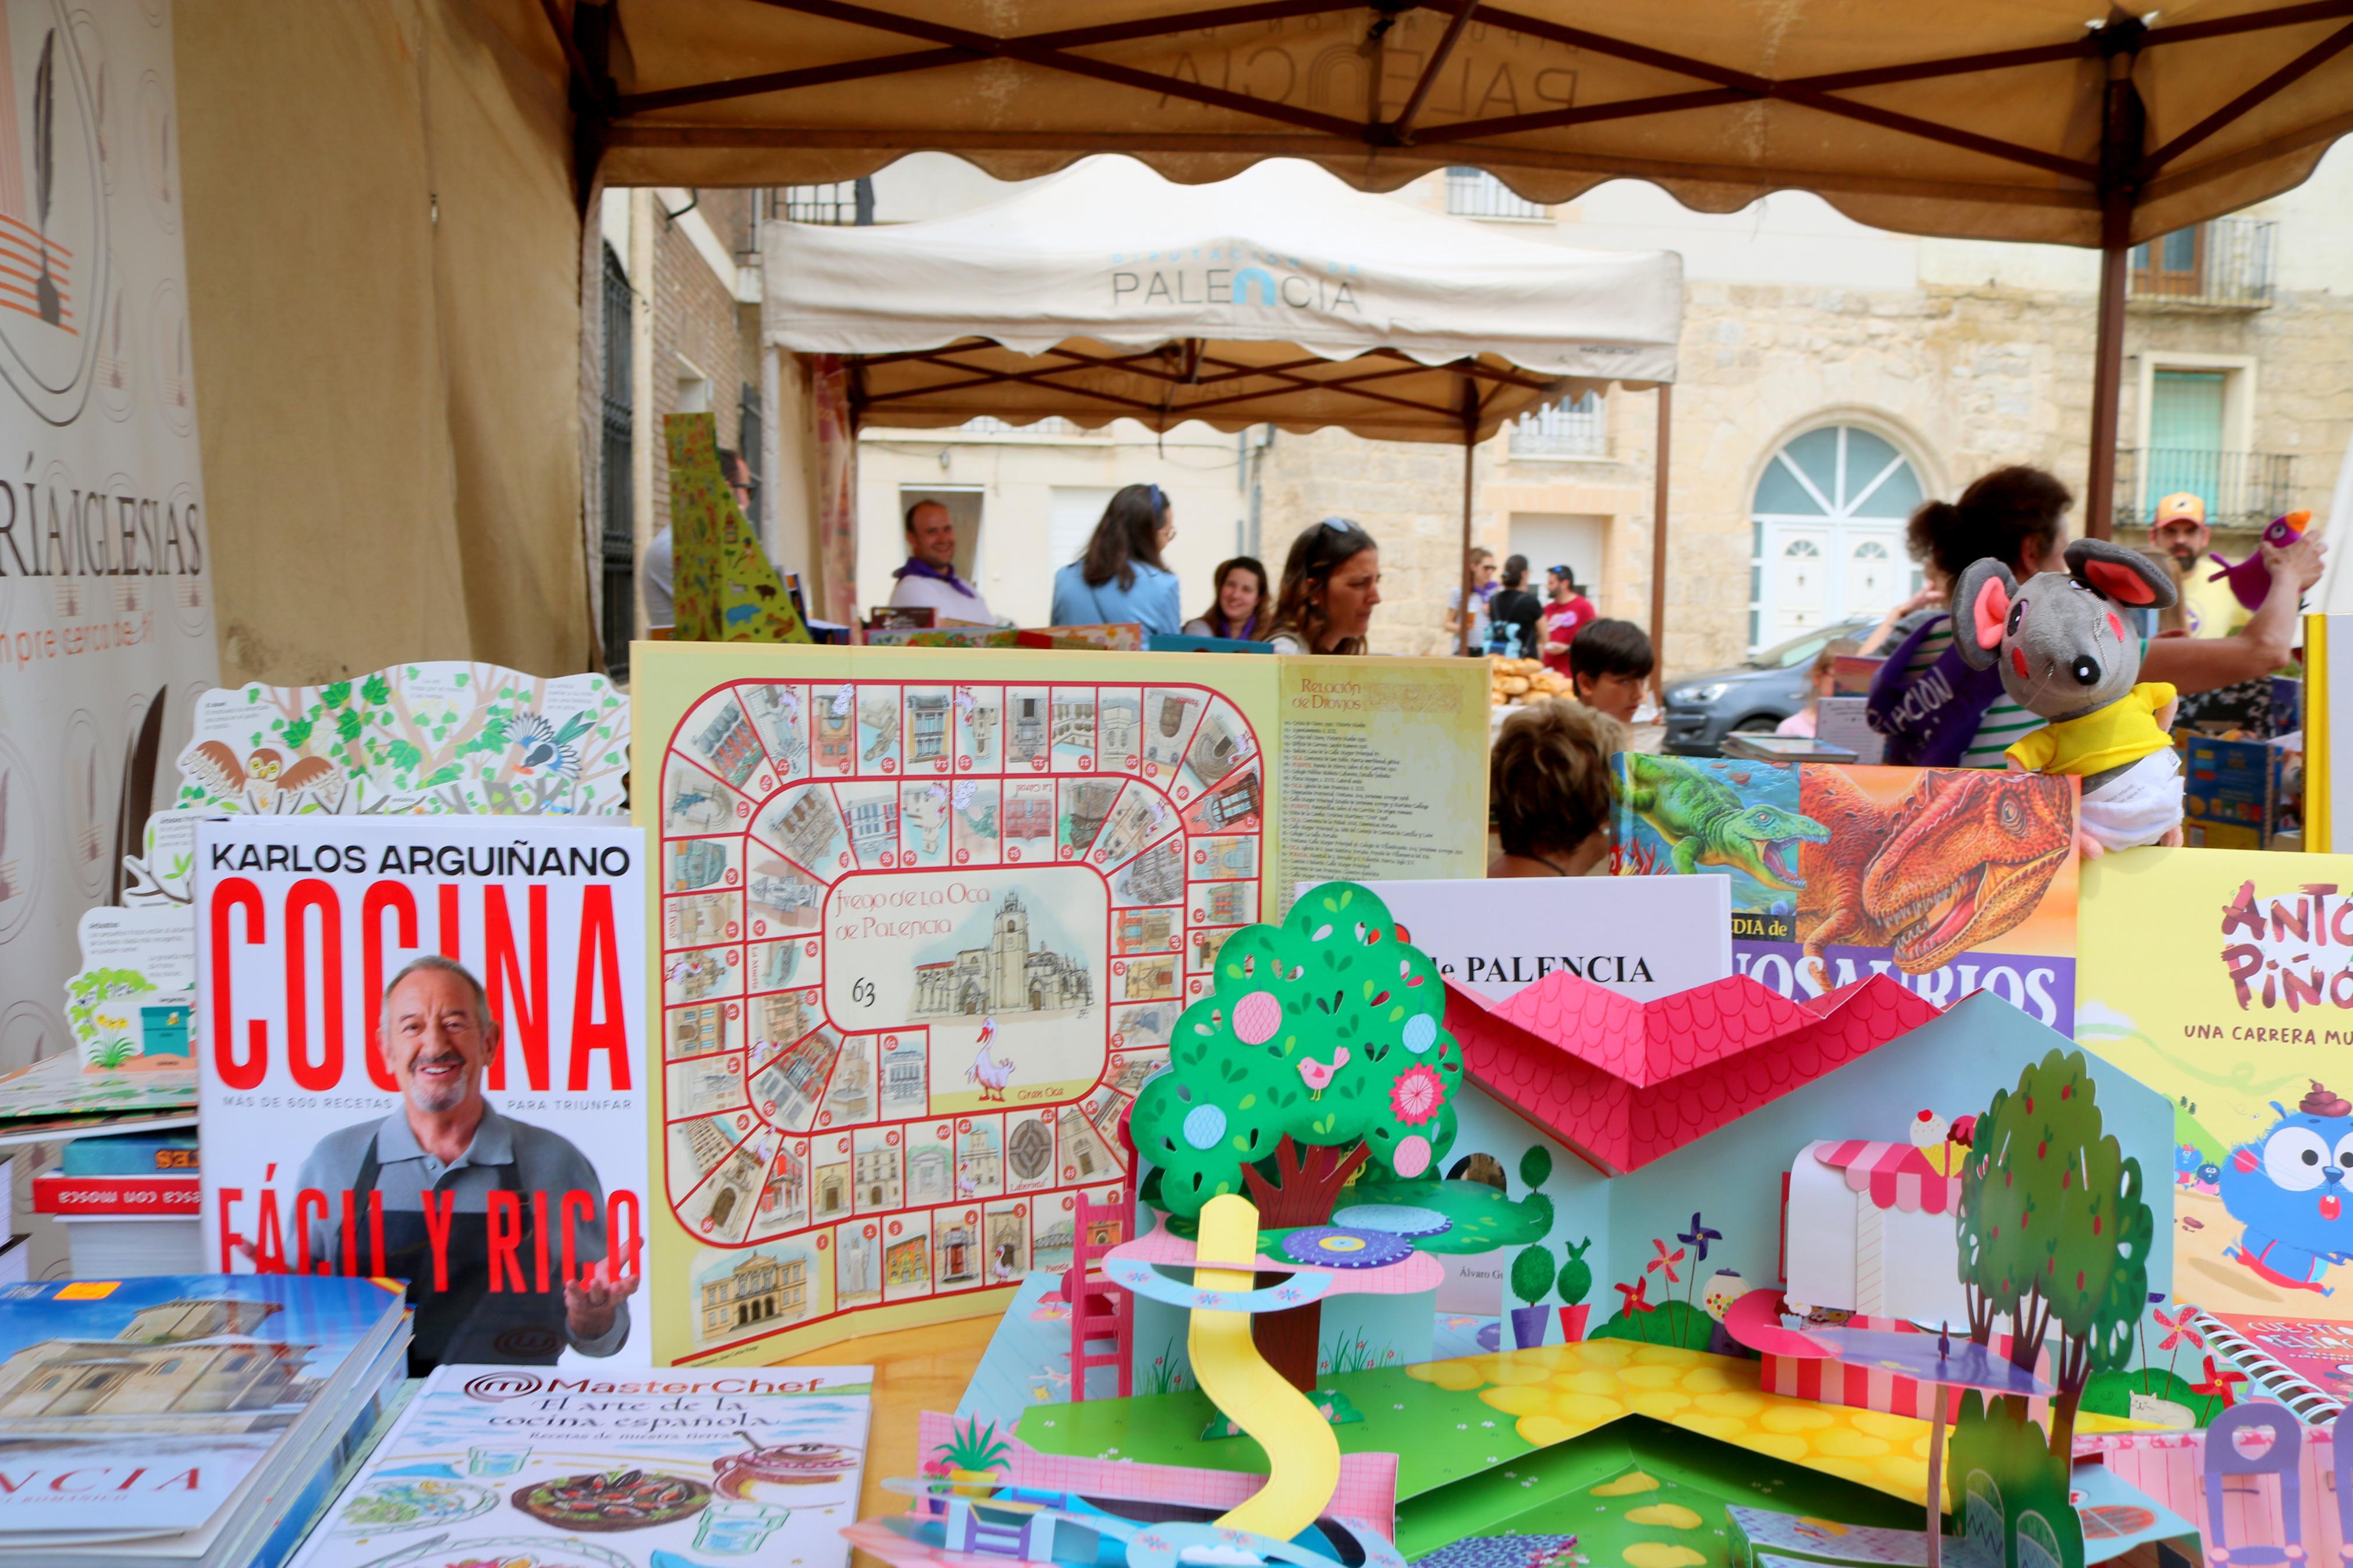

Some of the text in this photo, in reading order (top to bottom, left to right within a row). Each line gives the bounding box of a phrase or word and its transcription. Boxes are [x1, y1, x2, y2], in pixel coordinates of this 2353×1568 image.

[212, 840, 631, 877] KARLOS ARGUIÑANO
[890, 890, 917, 907] de
[947, 883, 991, 904] Oca
[835, 917, 952, 940] de Palencia
[1768, 920, 1788, 937] de
[1465, 955, 1655, 983] PALENCIA
[853, 976, 875, 1008] 63
[2184, 1024, 2224, 1040] UNA
[2233, 1026, 2316, 1045] CARRERA
[223, 1094, 633, 1112] MÁS DE 600 RECETAS PARA TRIUNFAR
[1017, 1086, 1064, 1101] Gran Oca
[58, 1190, 117, 1204] mosca
[123, 1190, 158, 1204] con
[421, 1190, 454, 1293] Y
[487, 1189, 640, 1293] RICO
[1460, 1265, 1490, 1278] Álvaro
[547, 1377, 825, 1395] MasterChef
[532, 1396, 748, 1412] El arte de la
[488, 1411, 779, 1432] cocina española
